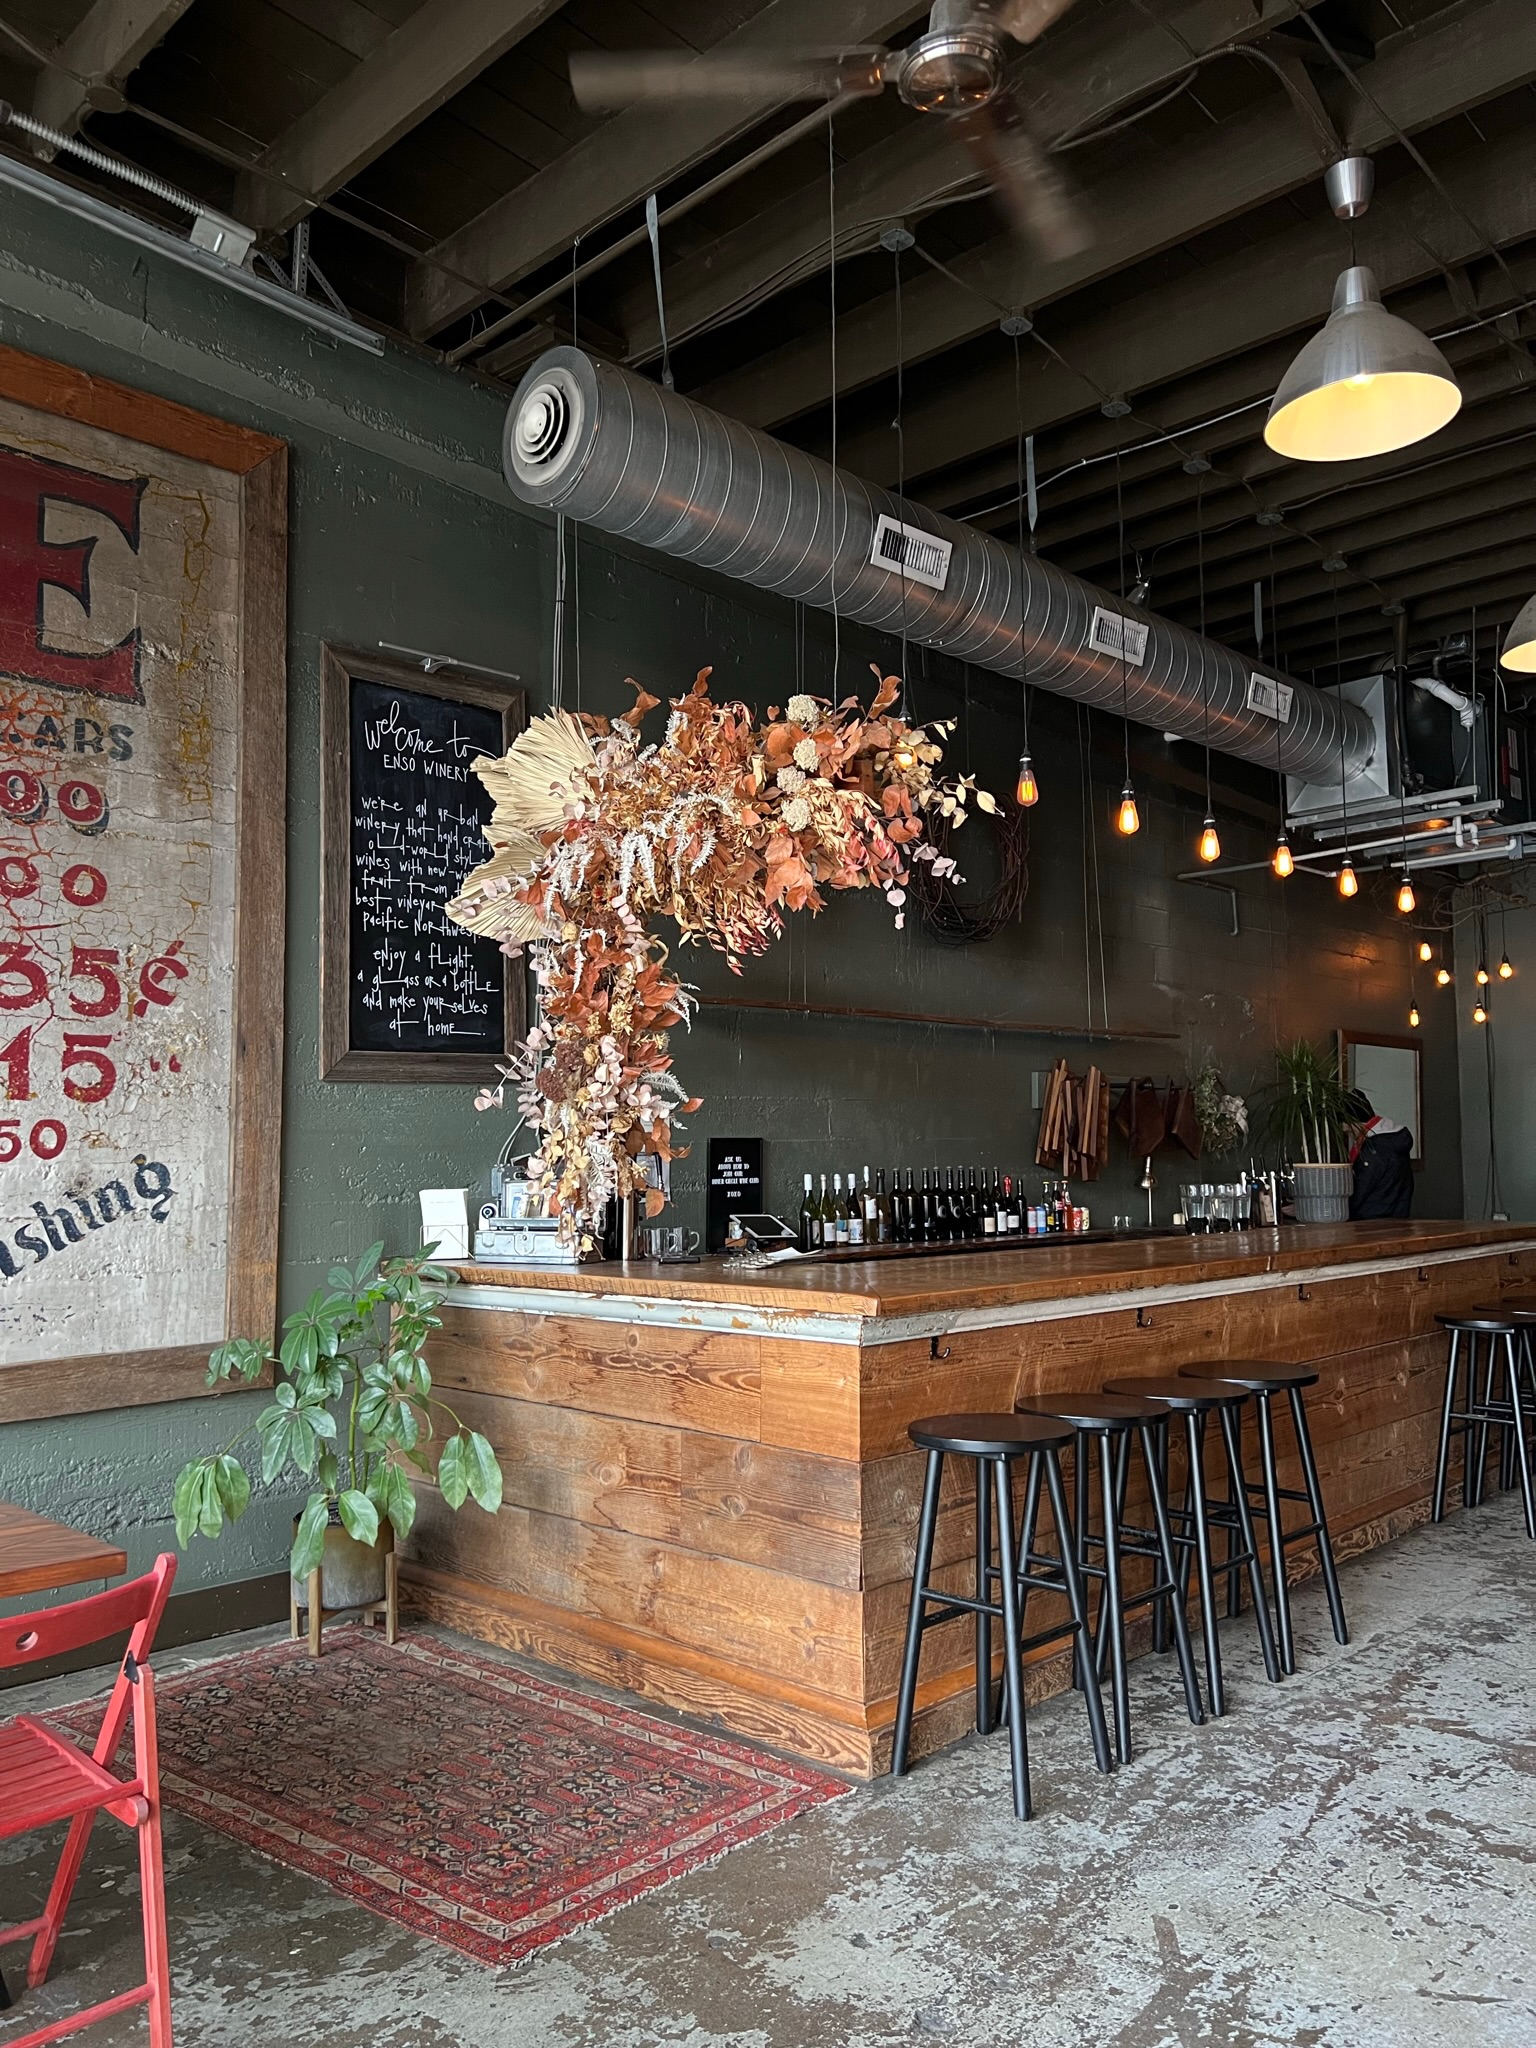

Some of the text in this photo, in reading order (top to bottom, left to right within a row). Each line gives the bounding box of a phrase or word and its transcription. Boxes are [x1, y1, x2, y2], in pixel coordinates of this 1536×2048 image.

[6, 712, 134, 761] ARS
[364, 700, 497, 758] Welcome to
[383, 753, 470, 783] ENSO WINERY
[405, 818, 435, 842] that
[400, 858, 423, 876] with
[361, 869, 401, 890] fruit
[406, 876, 448, 898] from
[355, 887, 393, 914] best
[415, 950, 421, 963] a
[357, 969, 364, 982] a
[424, 975, 442, 989] or
[442, 975, 447, 987] a
[389, 987, 417, 1013] make
[389, 1008, 420, 1038] at
